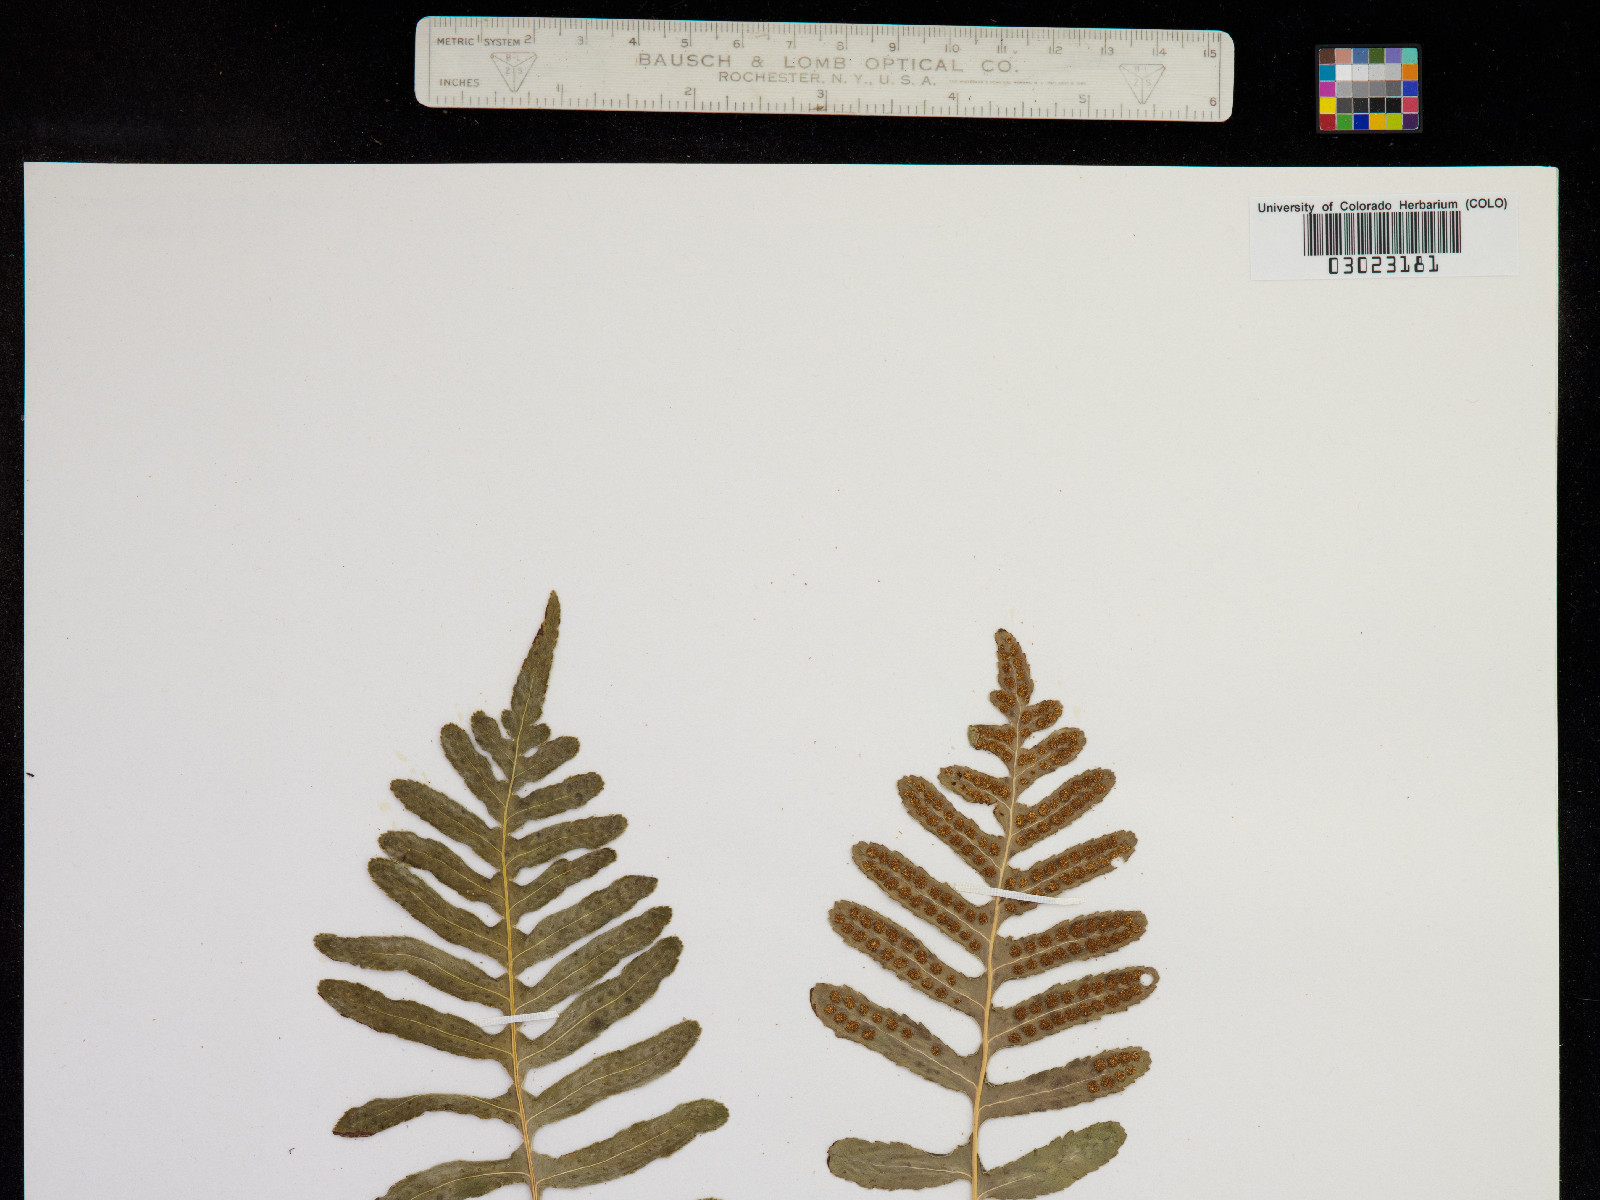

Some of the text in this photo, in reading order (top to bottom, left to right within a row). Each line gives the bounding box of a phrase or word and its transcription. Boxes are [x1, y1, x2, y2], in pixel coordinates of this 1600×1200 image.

[436, 37, 521, 47] METRIC SYSTEM
[524, 35, 532, 44] 2
[577, 36, 584, 45] 3
[628, 38, 637, 46] 4
[681, 38, 689, 48] 5
[733, 40, 741, 48] 6
[786, 40, 793, 49] 7
[836, 41, 845, 51] 8
[888, 42, 897, 52] 9
[638, 53, 1019, 73] BAUSCH & LOMB OPTICAL CO.
[439, 78, 480, 88] INCHES
[684, 87, 692, 96] 2
[817, 89, 824, 99] 3
[948, 92, 956, 100] 4
[1079, 94, 1087, 103] 5
[1209, 97, 1217, 106] 6
[1257, 197, 1508, 215] University of Colorado Herbarium (COLO)
[1328, 255, 1439, 274] 03023181
